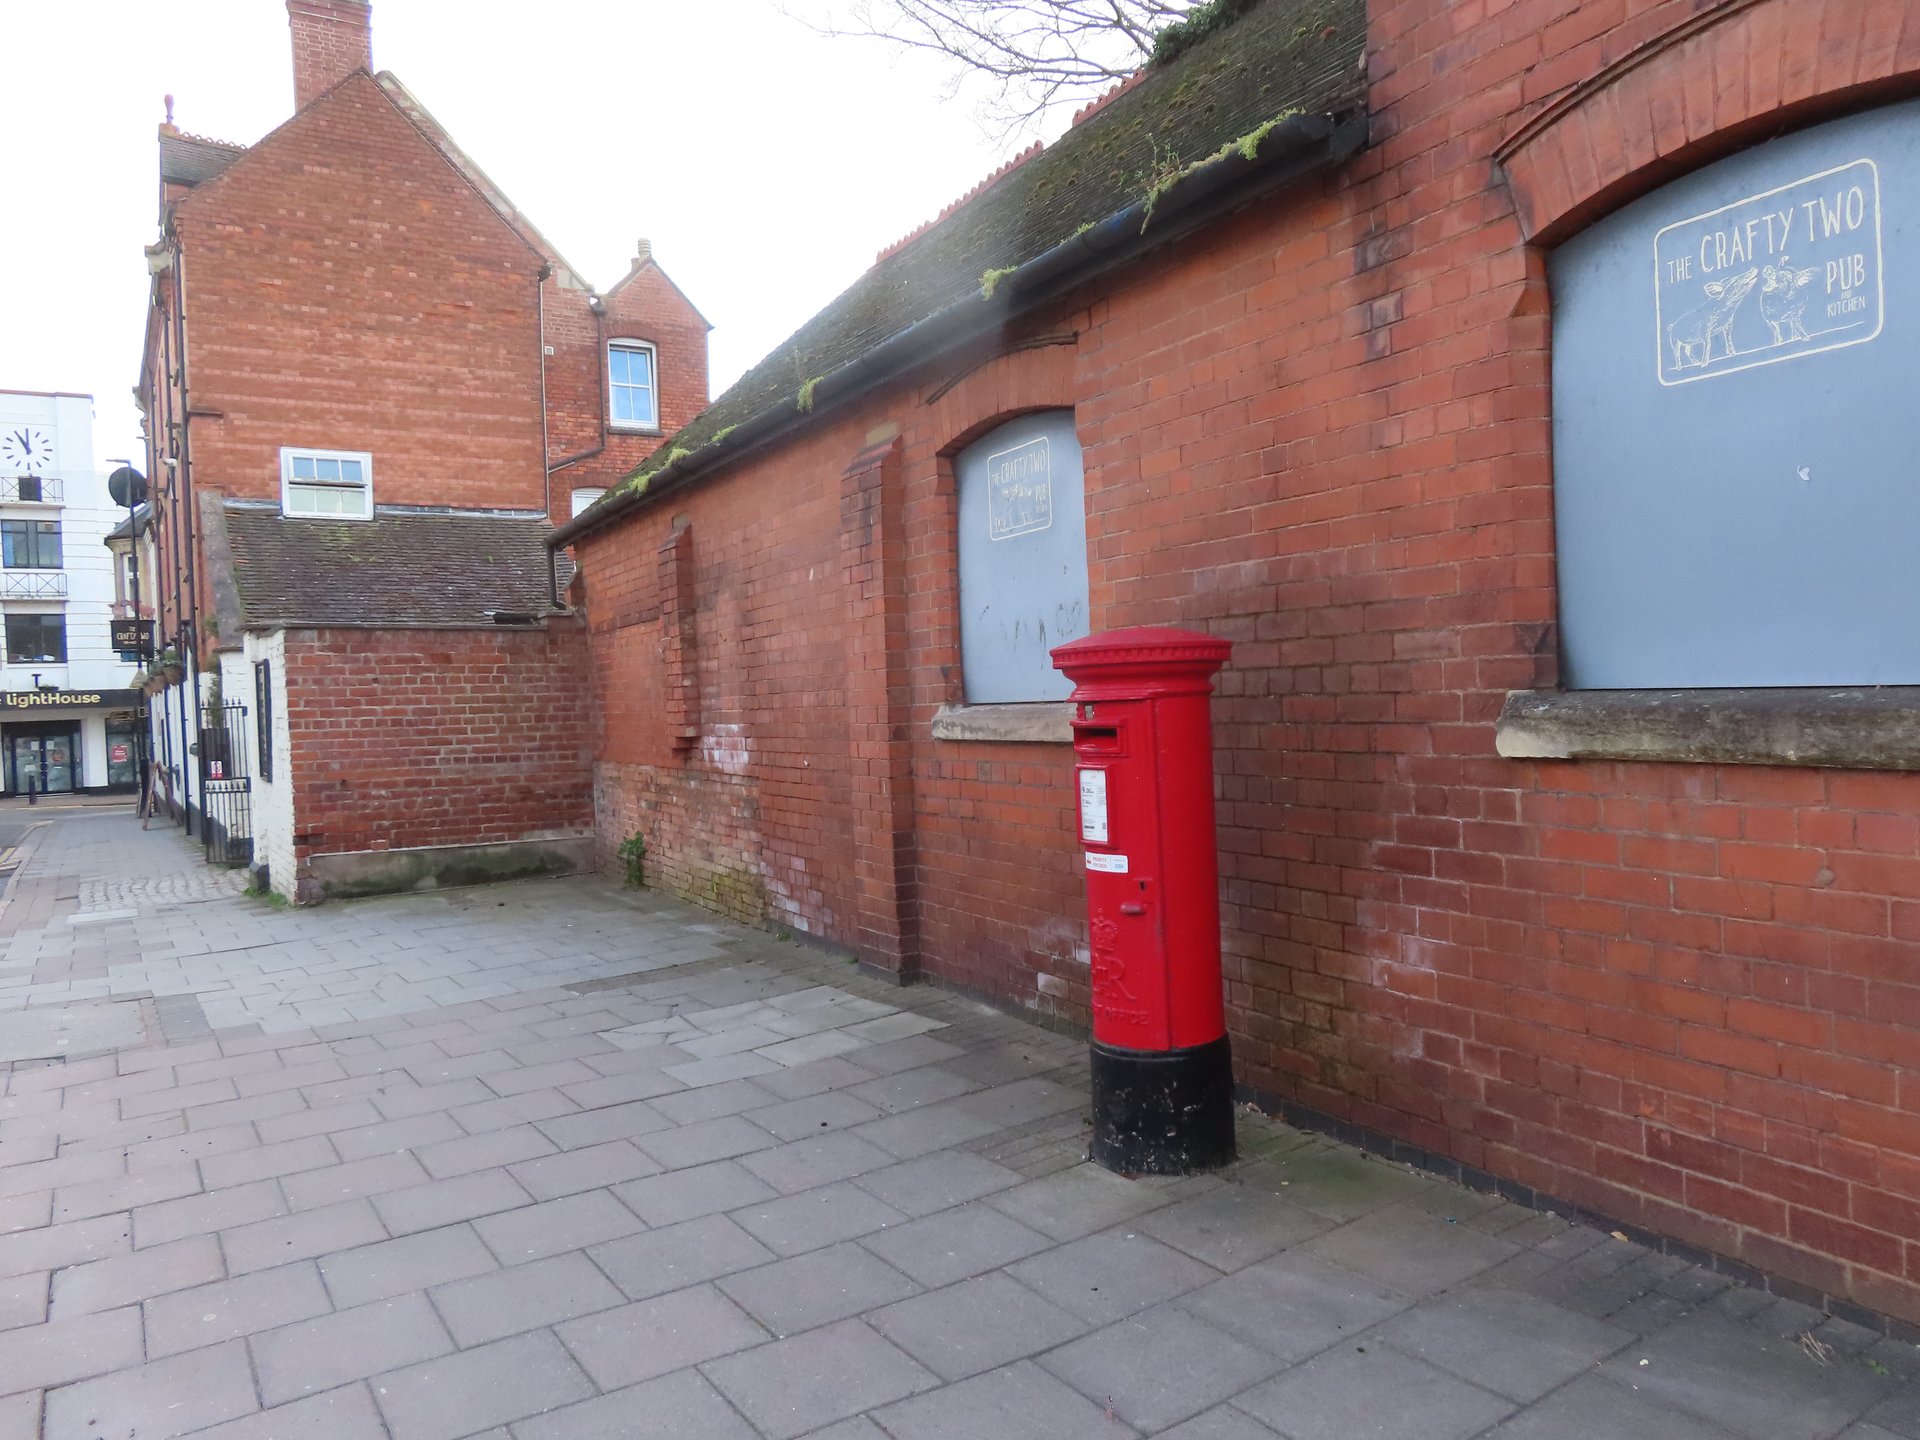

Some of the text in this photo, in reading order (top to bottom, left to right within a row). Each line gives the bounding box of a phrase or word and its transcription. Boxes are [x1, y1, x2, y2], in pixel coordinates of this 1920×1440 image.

[1667, 186, 1864, 284] THE CRAFTY TWO
[1826, 254, 1865, 294] PUB
[1827, 295, 1866, 318] KITCHEN
[1001, 456, 1028, 484] CRAFTY
[1029, 449, 1046, 474] TWO
